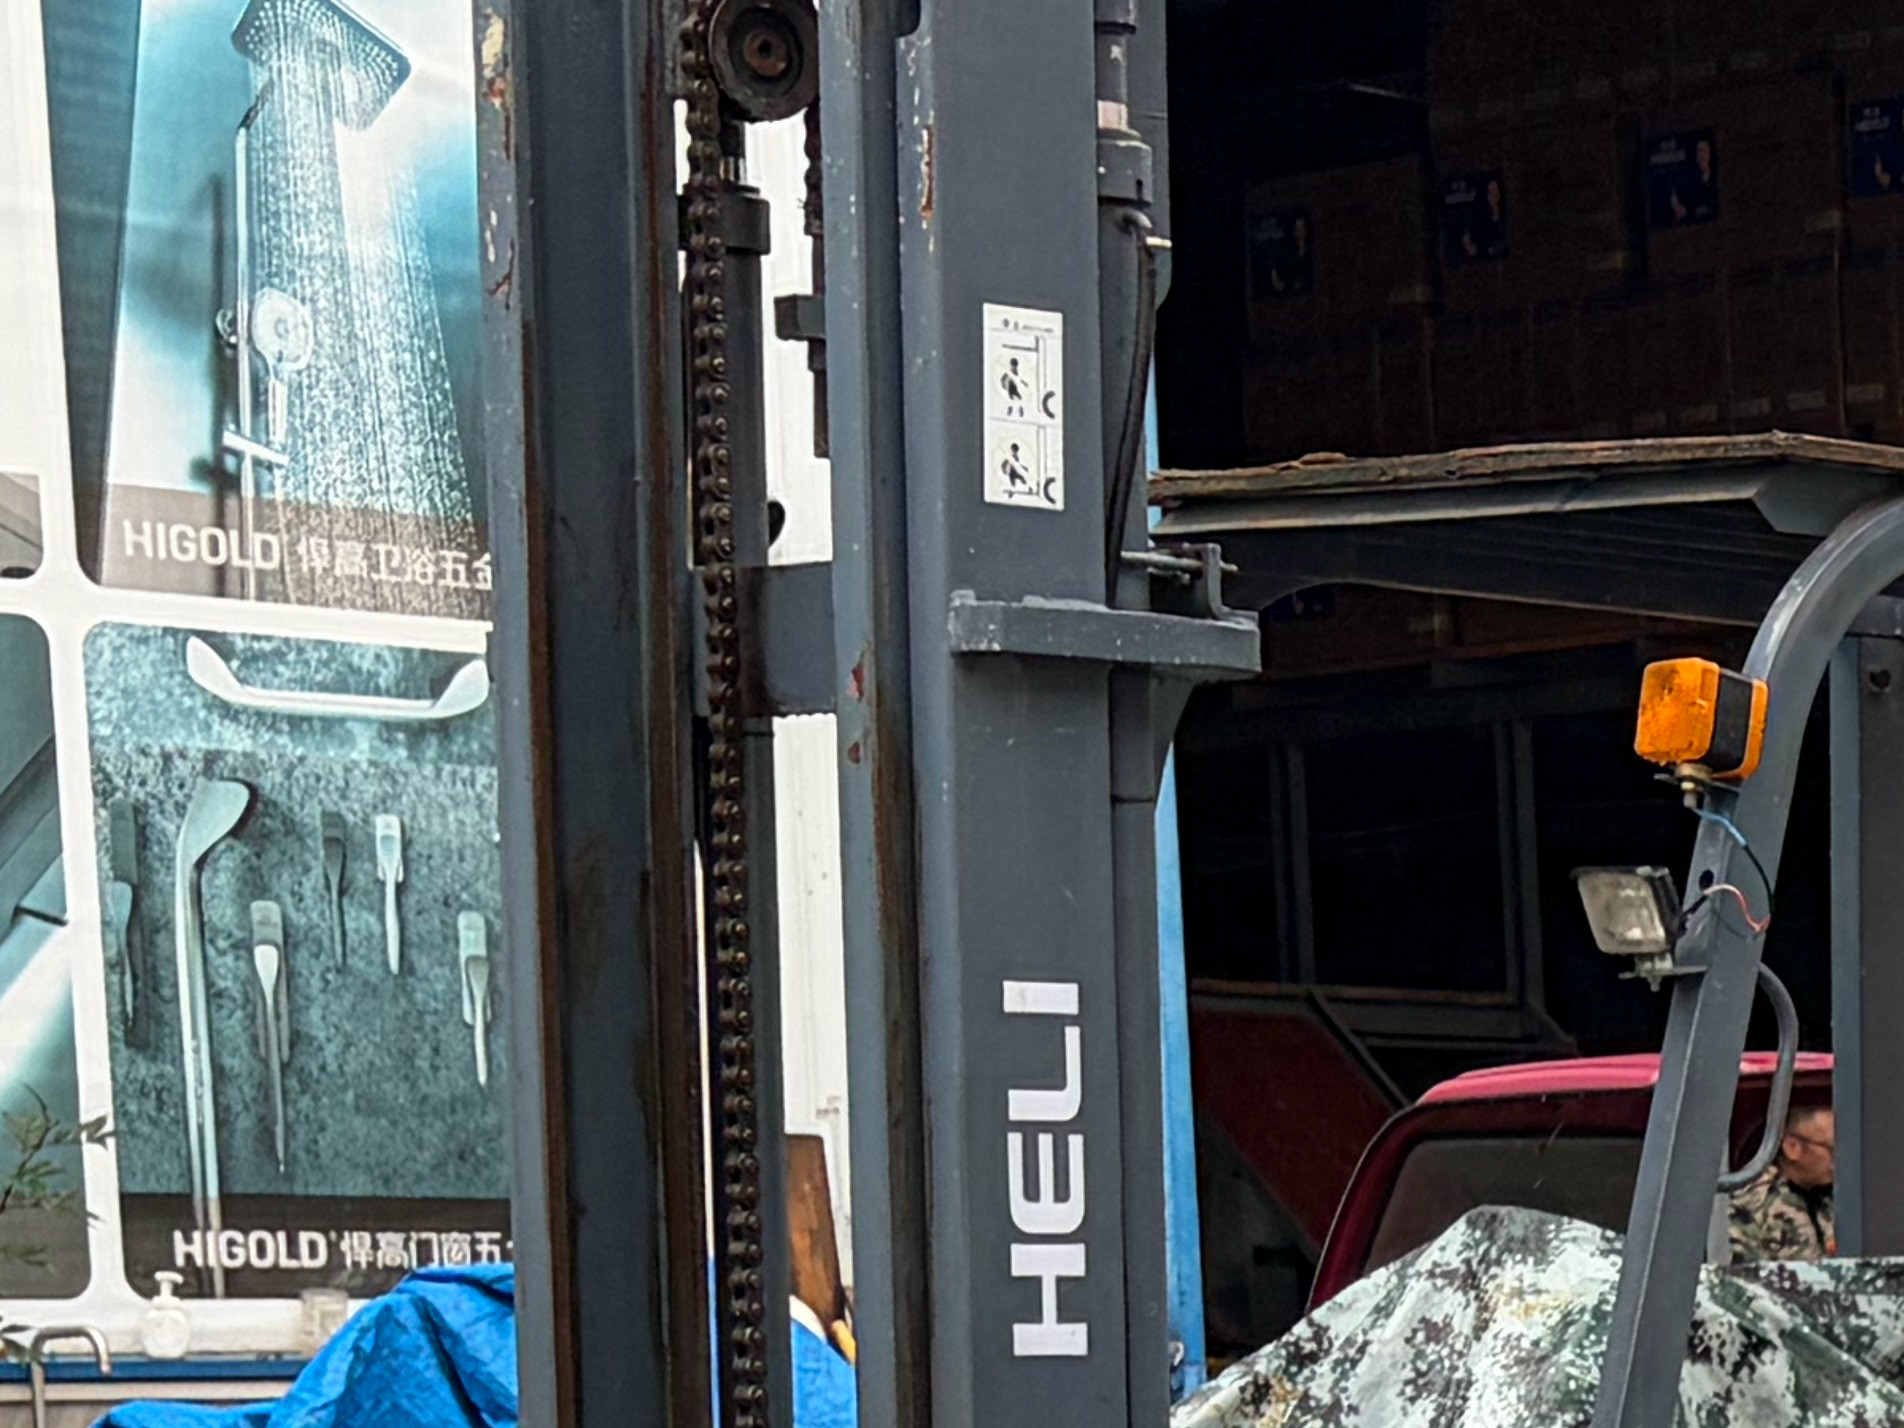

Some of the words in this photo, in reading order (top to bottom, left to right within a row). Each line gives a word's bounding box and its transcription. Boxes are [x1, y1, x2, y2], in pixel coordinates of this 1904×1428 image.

[122, 518, 281, 570] HIGOLD
[1003, 980, 1089, 1358] HELI
[173, 1229, 329, 1269] HIGOLD
[340, 1230, 513, 1270] 悍高门窗五
